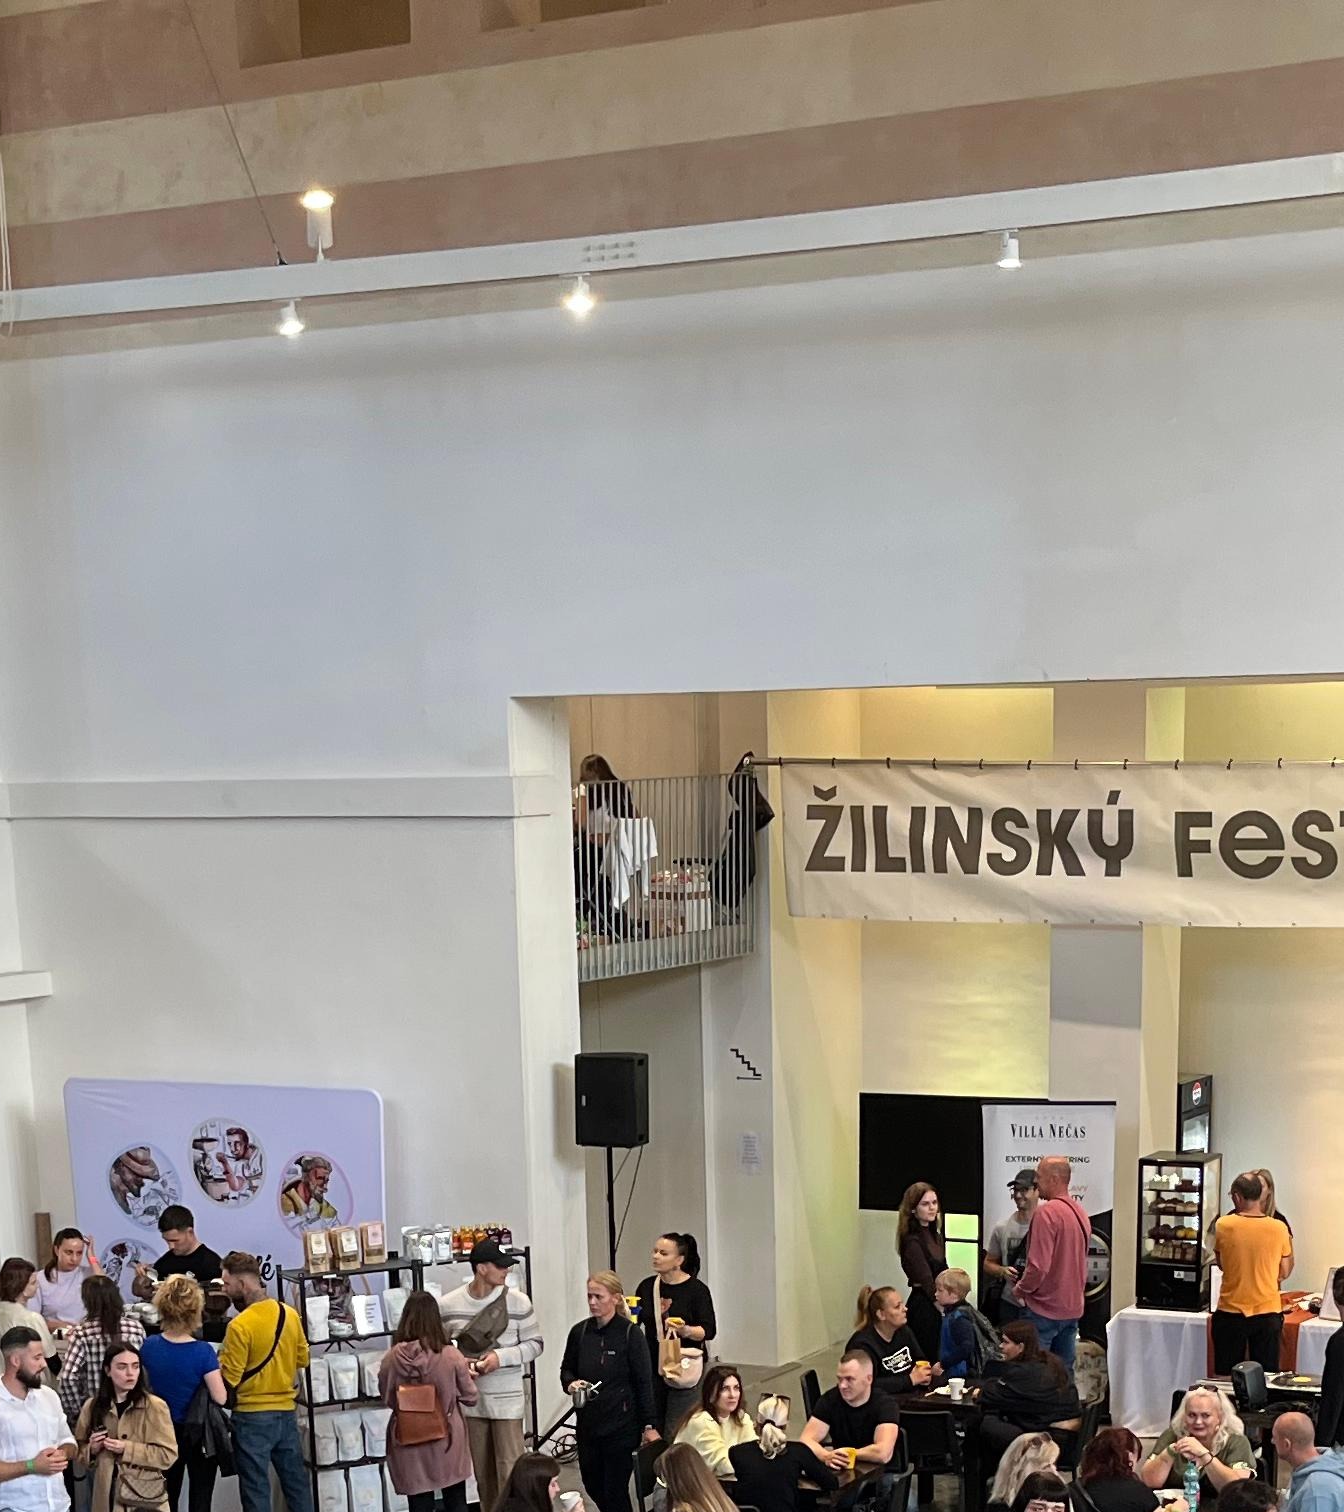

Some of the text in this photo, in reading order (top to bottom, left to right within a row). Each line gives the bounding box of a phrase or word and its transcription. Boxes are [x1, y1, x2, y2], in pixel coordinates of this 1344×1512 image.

[804, 785, 1135, 878] ŽILINSKÝ
[1010, 1122, 1087, 1139] VILLA NEČAS
